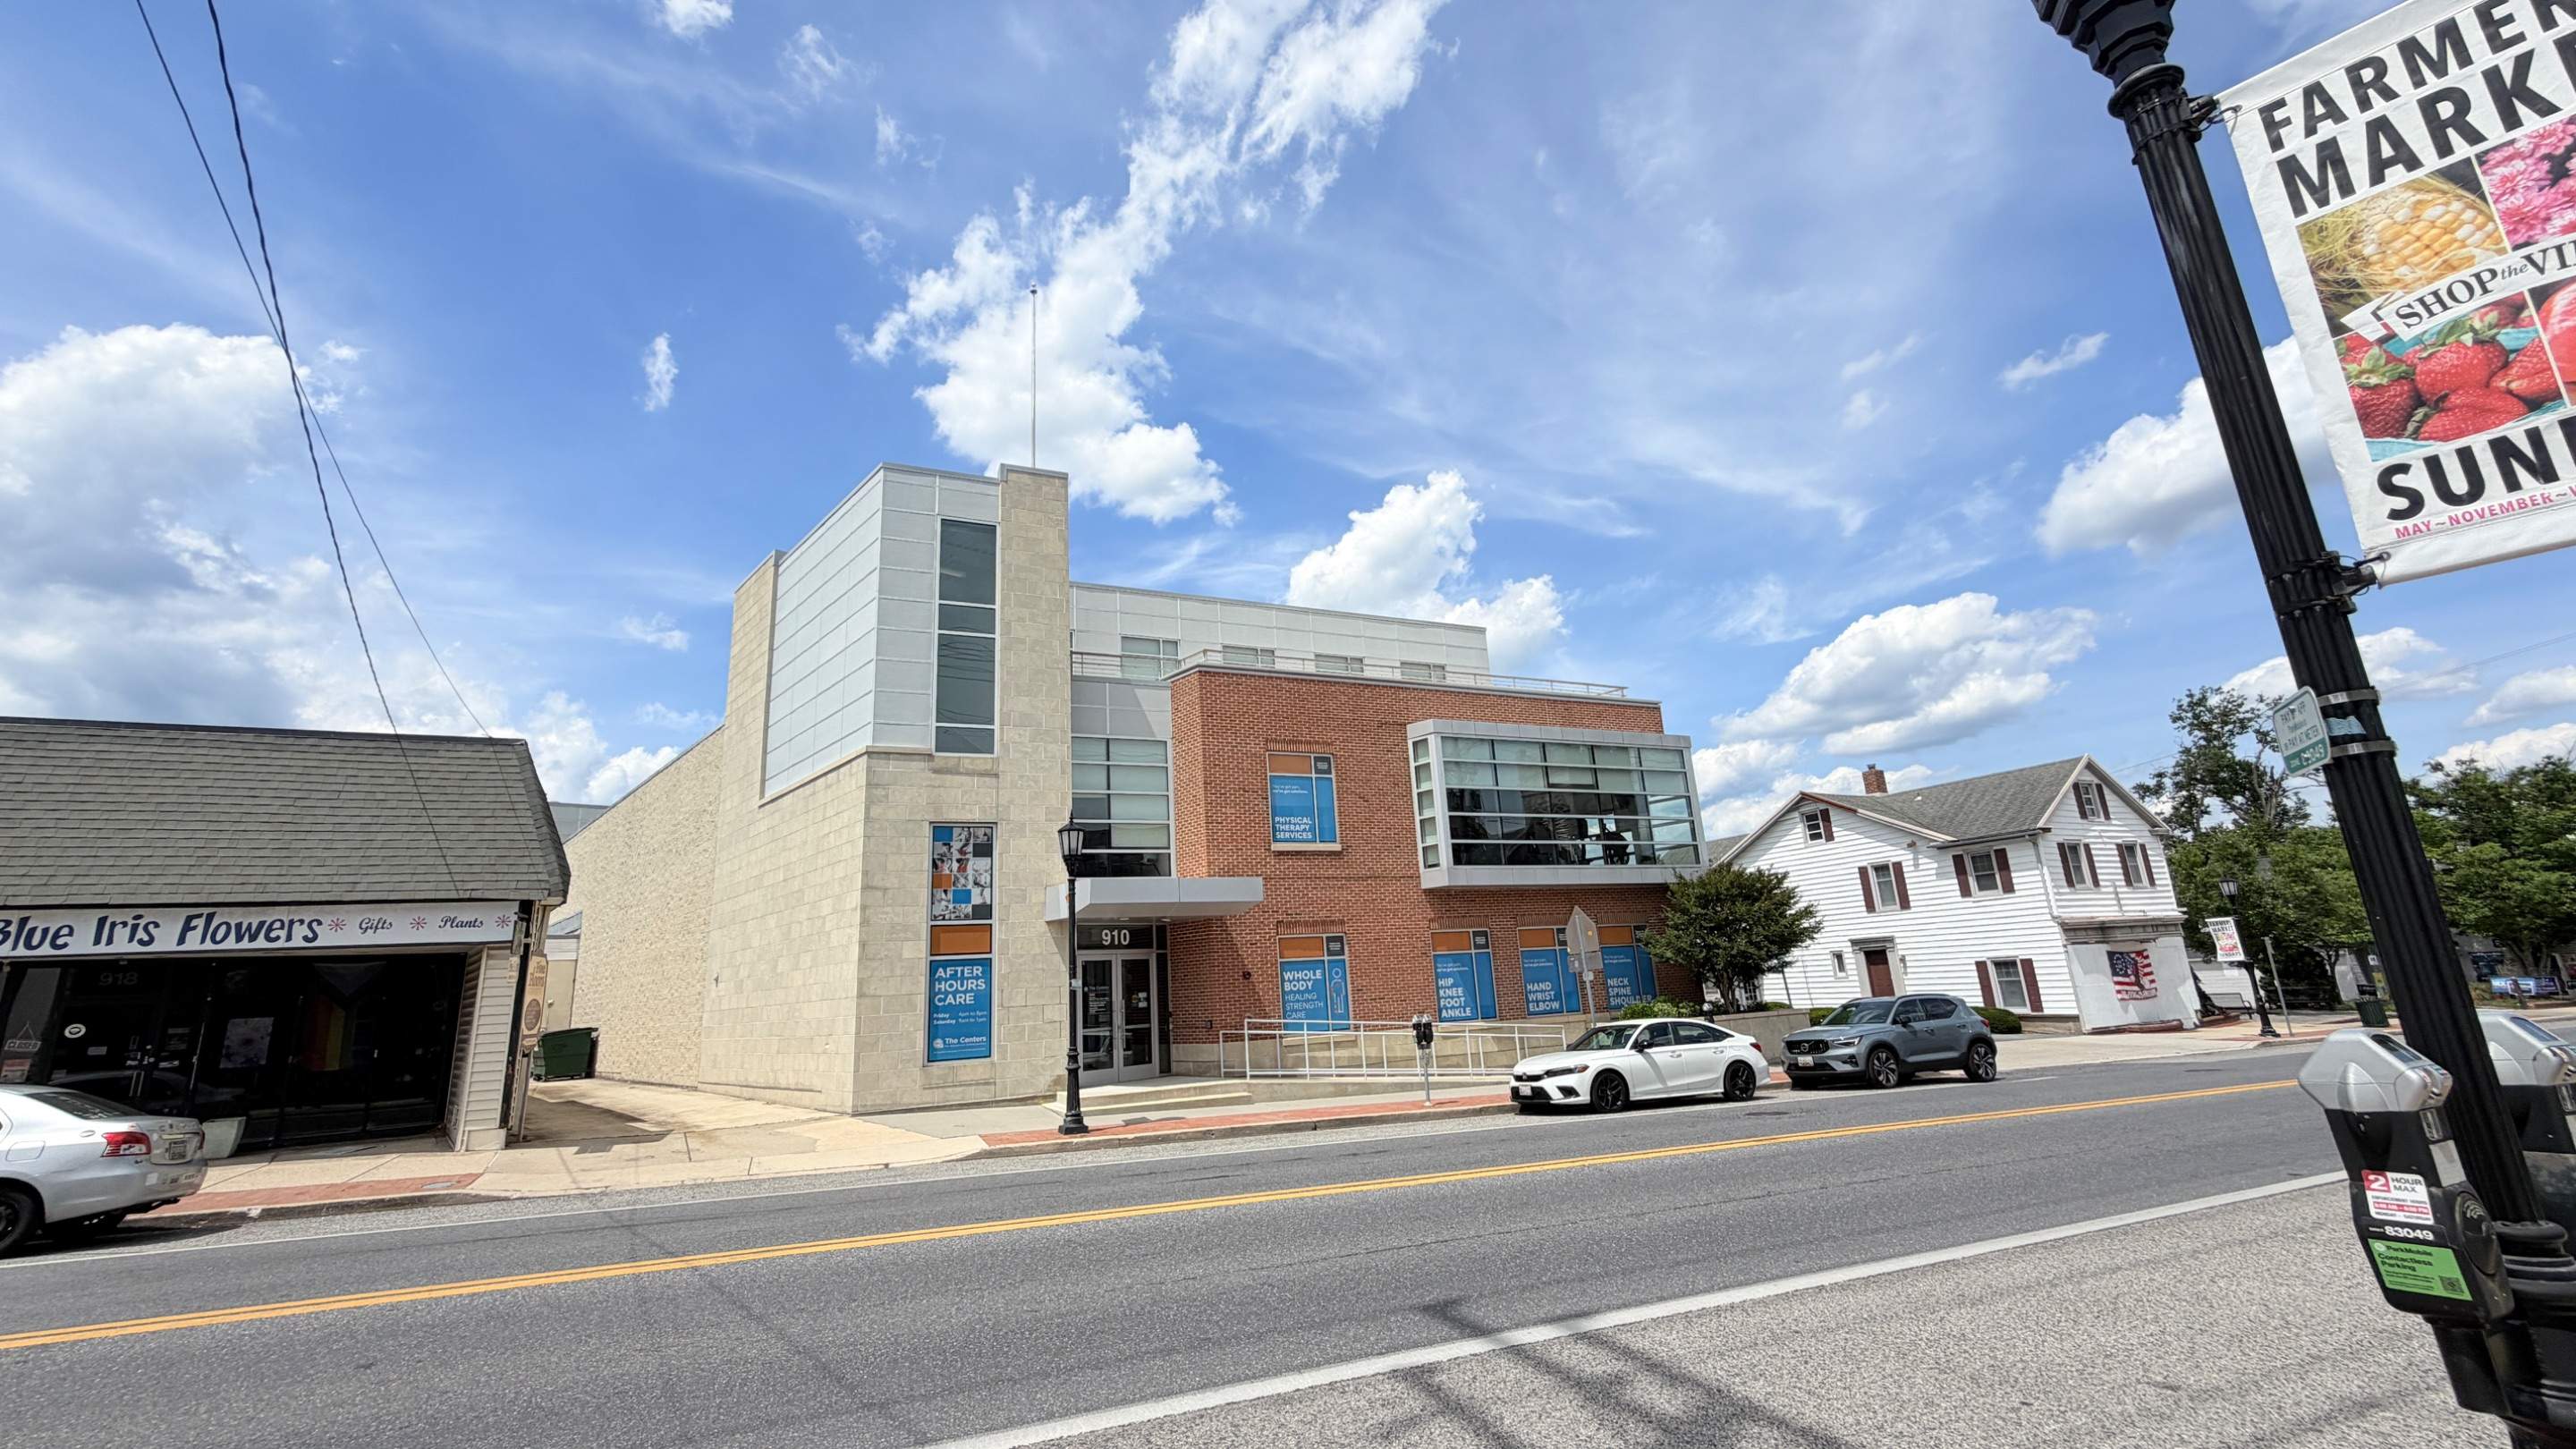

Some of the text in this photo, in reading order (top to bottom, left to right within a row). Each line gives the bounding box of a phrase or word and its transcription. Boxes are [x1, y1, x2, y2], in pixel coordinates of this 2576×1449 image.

[2395, 241, 2576, 329] SHOP the VI
[1275, 831, 1312, 839] SERVICES
[359, 917, 394, 935] Gifts
[437, 915, 484, 930] Plants
[92, 914, 161, 946] Iris
[176, 911, 323, 946] Flowers
[1102, 929, 1130, 945] 910
[935, 966, 982, 979] AFTER
[1283, 970, 1322, 980] WHOLE
[99, 972, 140, 986] 918
[1438, 978, 1453, 987] HIP
[1607, 977, 1630, 987] NECK
[935, 979, 986, 992] HOURS
[1284, 980, 1313, 991] BODY
[1526, 981, 1552, 992] HAND
[1285, 992, 1318, 1001] HEALING
[1439, 987, 1464, 997] KNEE
[1528, 991, 1555, 1001] WRIST
[1609, 987, 1632, 996] SPINE
[935, 993, 975, 1006] CARE
[1440, 997, 1465, 1008] FOOT
[1285, 1001, 1324, 1011] STRENGTH
[1529, 1001, 1560, 1012] ELBOW
[1286, 1011, 1307, 1019] CARE
[1441, 1007, 1472, 1018] ANKLE
[960, 1036, 987, 1044] Centers
[2368, 1174, 2423, 1191] 2 HOUR
[2394, 1185, 2419, 1193] MAX
[2385, 1225, 2435, 1241] 83049
